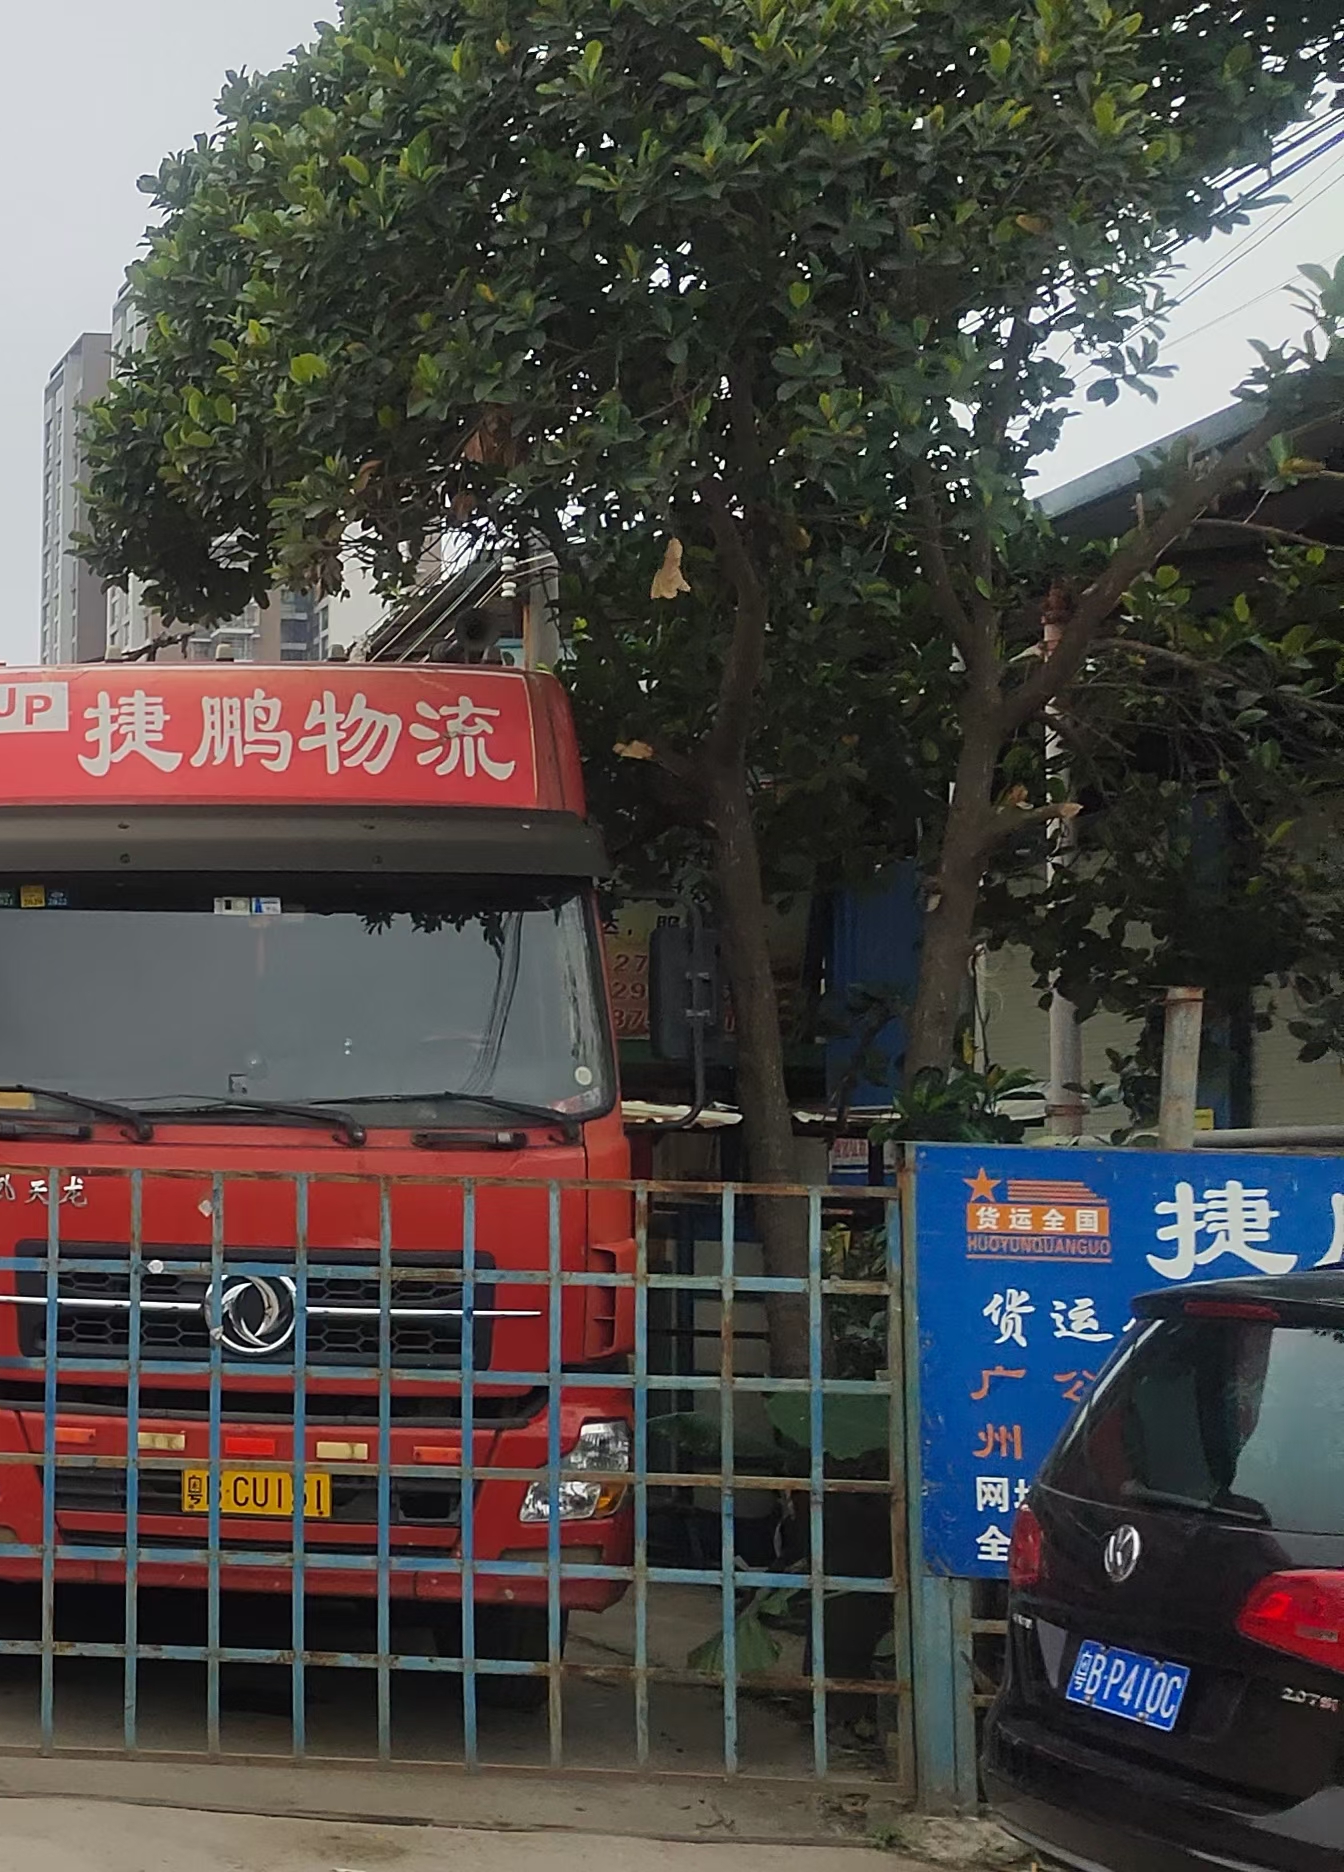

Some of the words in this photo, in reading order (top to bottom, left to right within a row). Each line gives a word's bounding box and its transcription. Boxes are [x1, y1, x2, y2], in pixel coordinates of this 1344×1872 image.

[78, 688, 515, 781] 捷鹏物流
[976, 1206, 1099, 1233] 货运全国
[967, 1236, 1110, 1256] HUOYUNQUANGUO
[983, 1288, 1136, 1347] 货运
